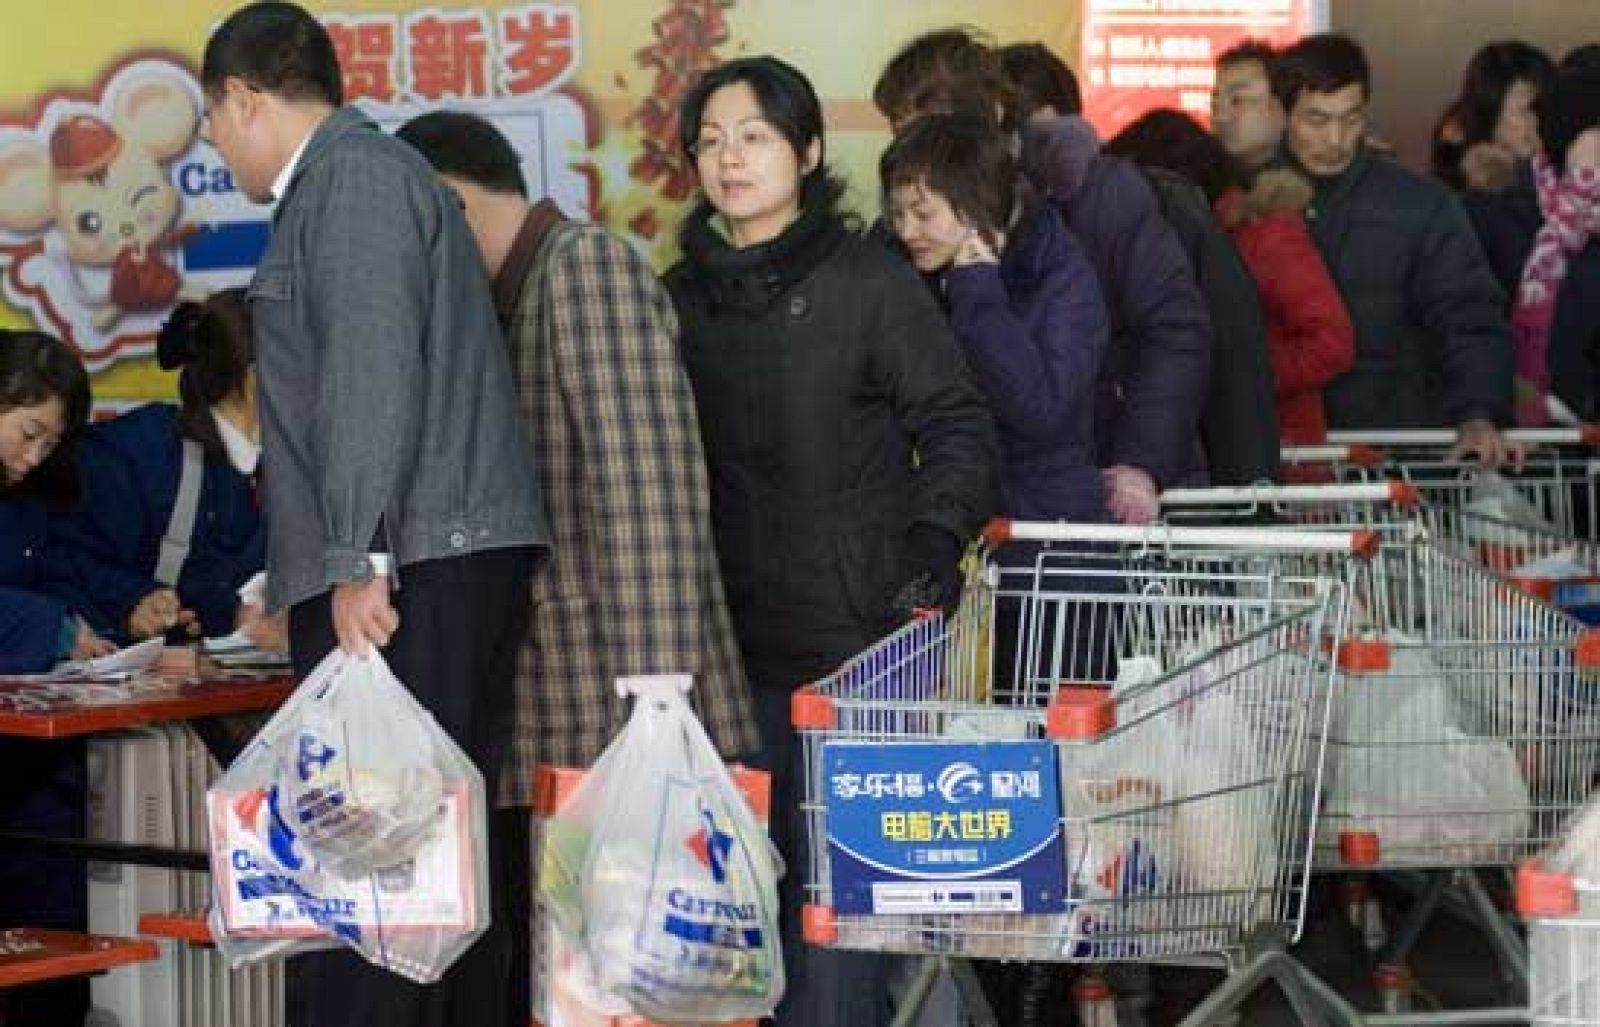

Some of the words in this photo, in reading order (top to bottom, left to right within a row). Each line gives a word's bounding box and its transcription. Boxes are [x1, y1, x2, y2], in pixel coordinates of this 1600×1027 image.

[328, 11, 573, 103] 贺新岁
[880, 809, 1012, 841] 电脑大世界
